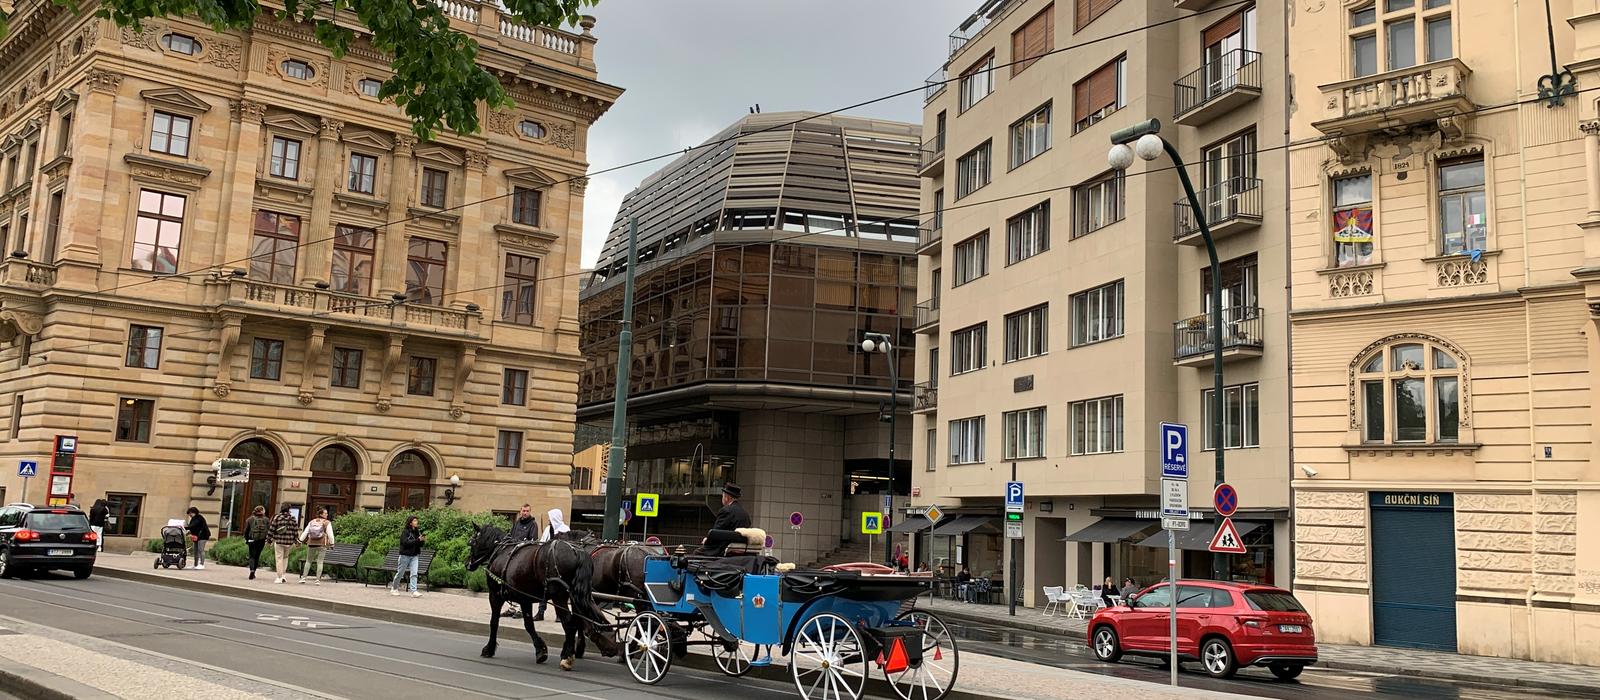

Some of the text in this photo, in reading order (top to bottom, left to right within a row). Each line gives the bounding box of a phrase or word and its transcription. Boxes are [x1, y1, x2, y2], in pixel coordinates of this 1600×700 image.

[1167, 430, 1182, 460] P
[1010, 487, 1020, 501] P
[1385, 494, 1420, 504] AUKČNÍ
